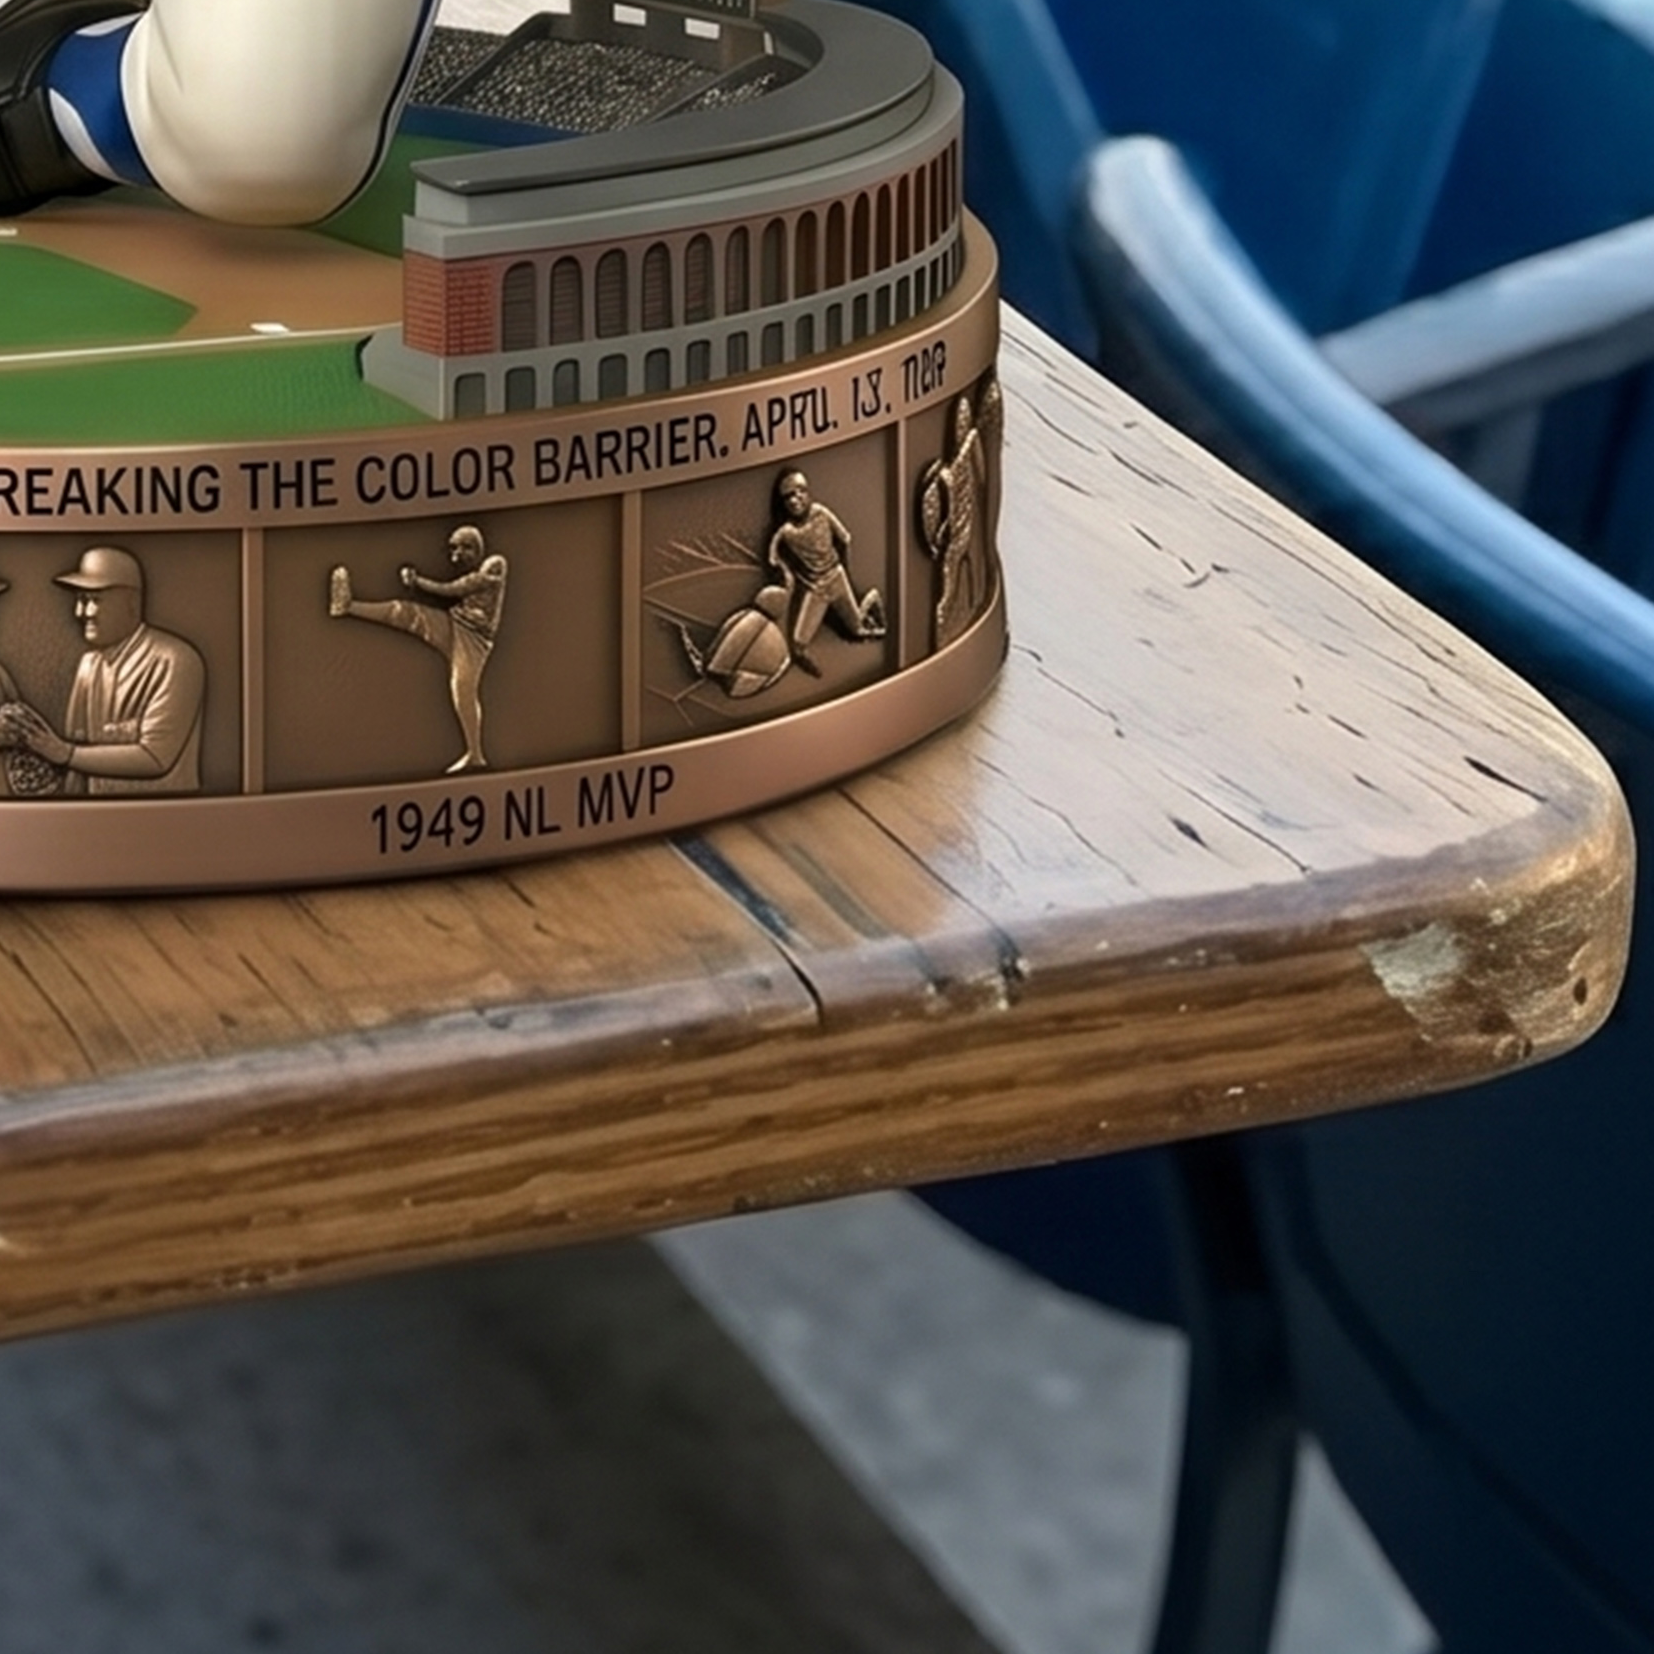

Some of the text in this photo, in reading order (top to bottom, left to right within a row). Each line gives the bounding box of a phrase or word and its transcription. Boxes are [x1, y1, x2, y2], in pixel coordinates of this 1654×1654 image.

[239, 458, 339, 511] THE
[355, 443, 516, 505] COLOR
[370, 763, 676, 855] 1949 NL MVP
